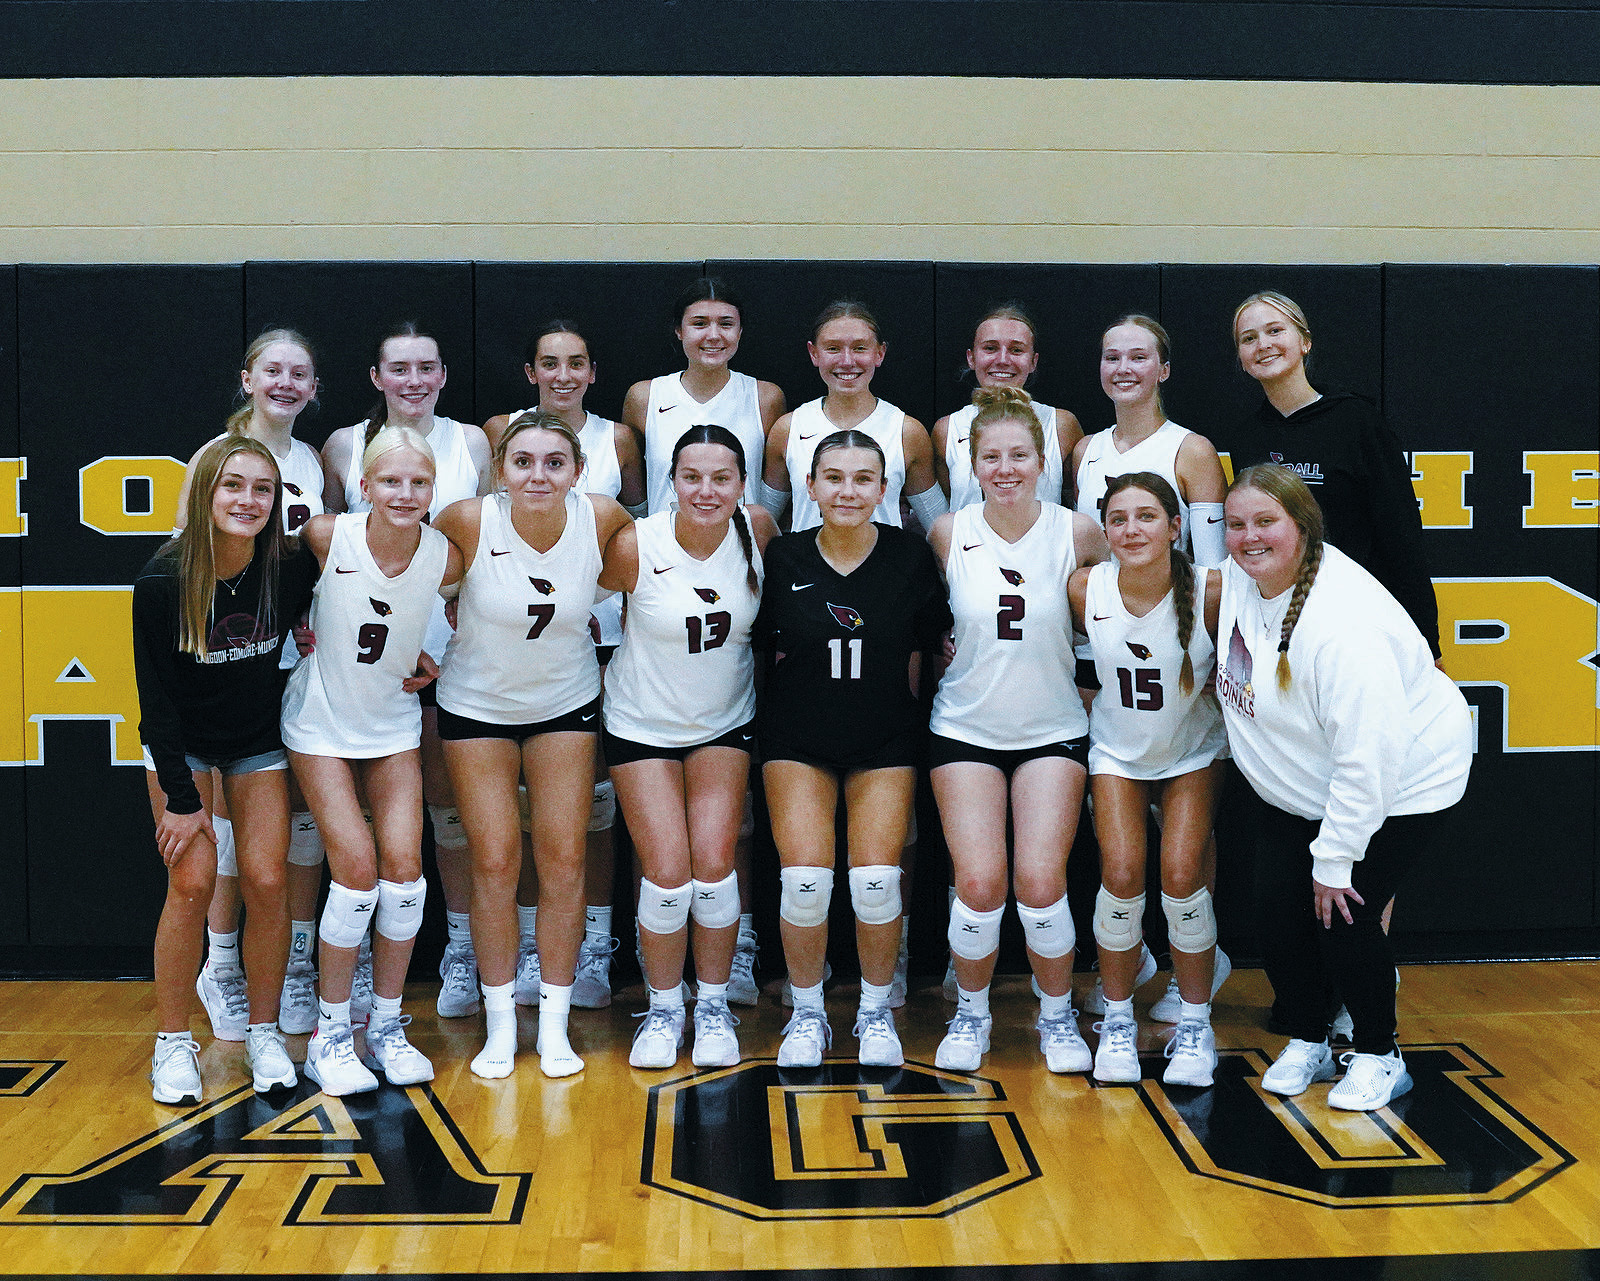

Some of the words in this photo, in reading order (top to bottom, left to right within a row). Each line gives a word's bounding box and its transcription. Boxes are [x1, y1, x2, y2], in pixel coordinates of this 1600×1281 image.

[526, 603, 556, 640] 7
[685, 610, 732, 655] 13
[997, 595, 1026, 640] 2
[356, 623, 389, 665] 9
[827, 639, 863, 680] 11
[1117, 667, 1164, 712] 15
[0, 1043, 1578, 1226] AGU
